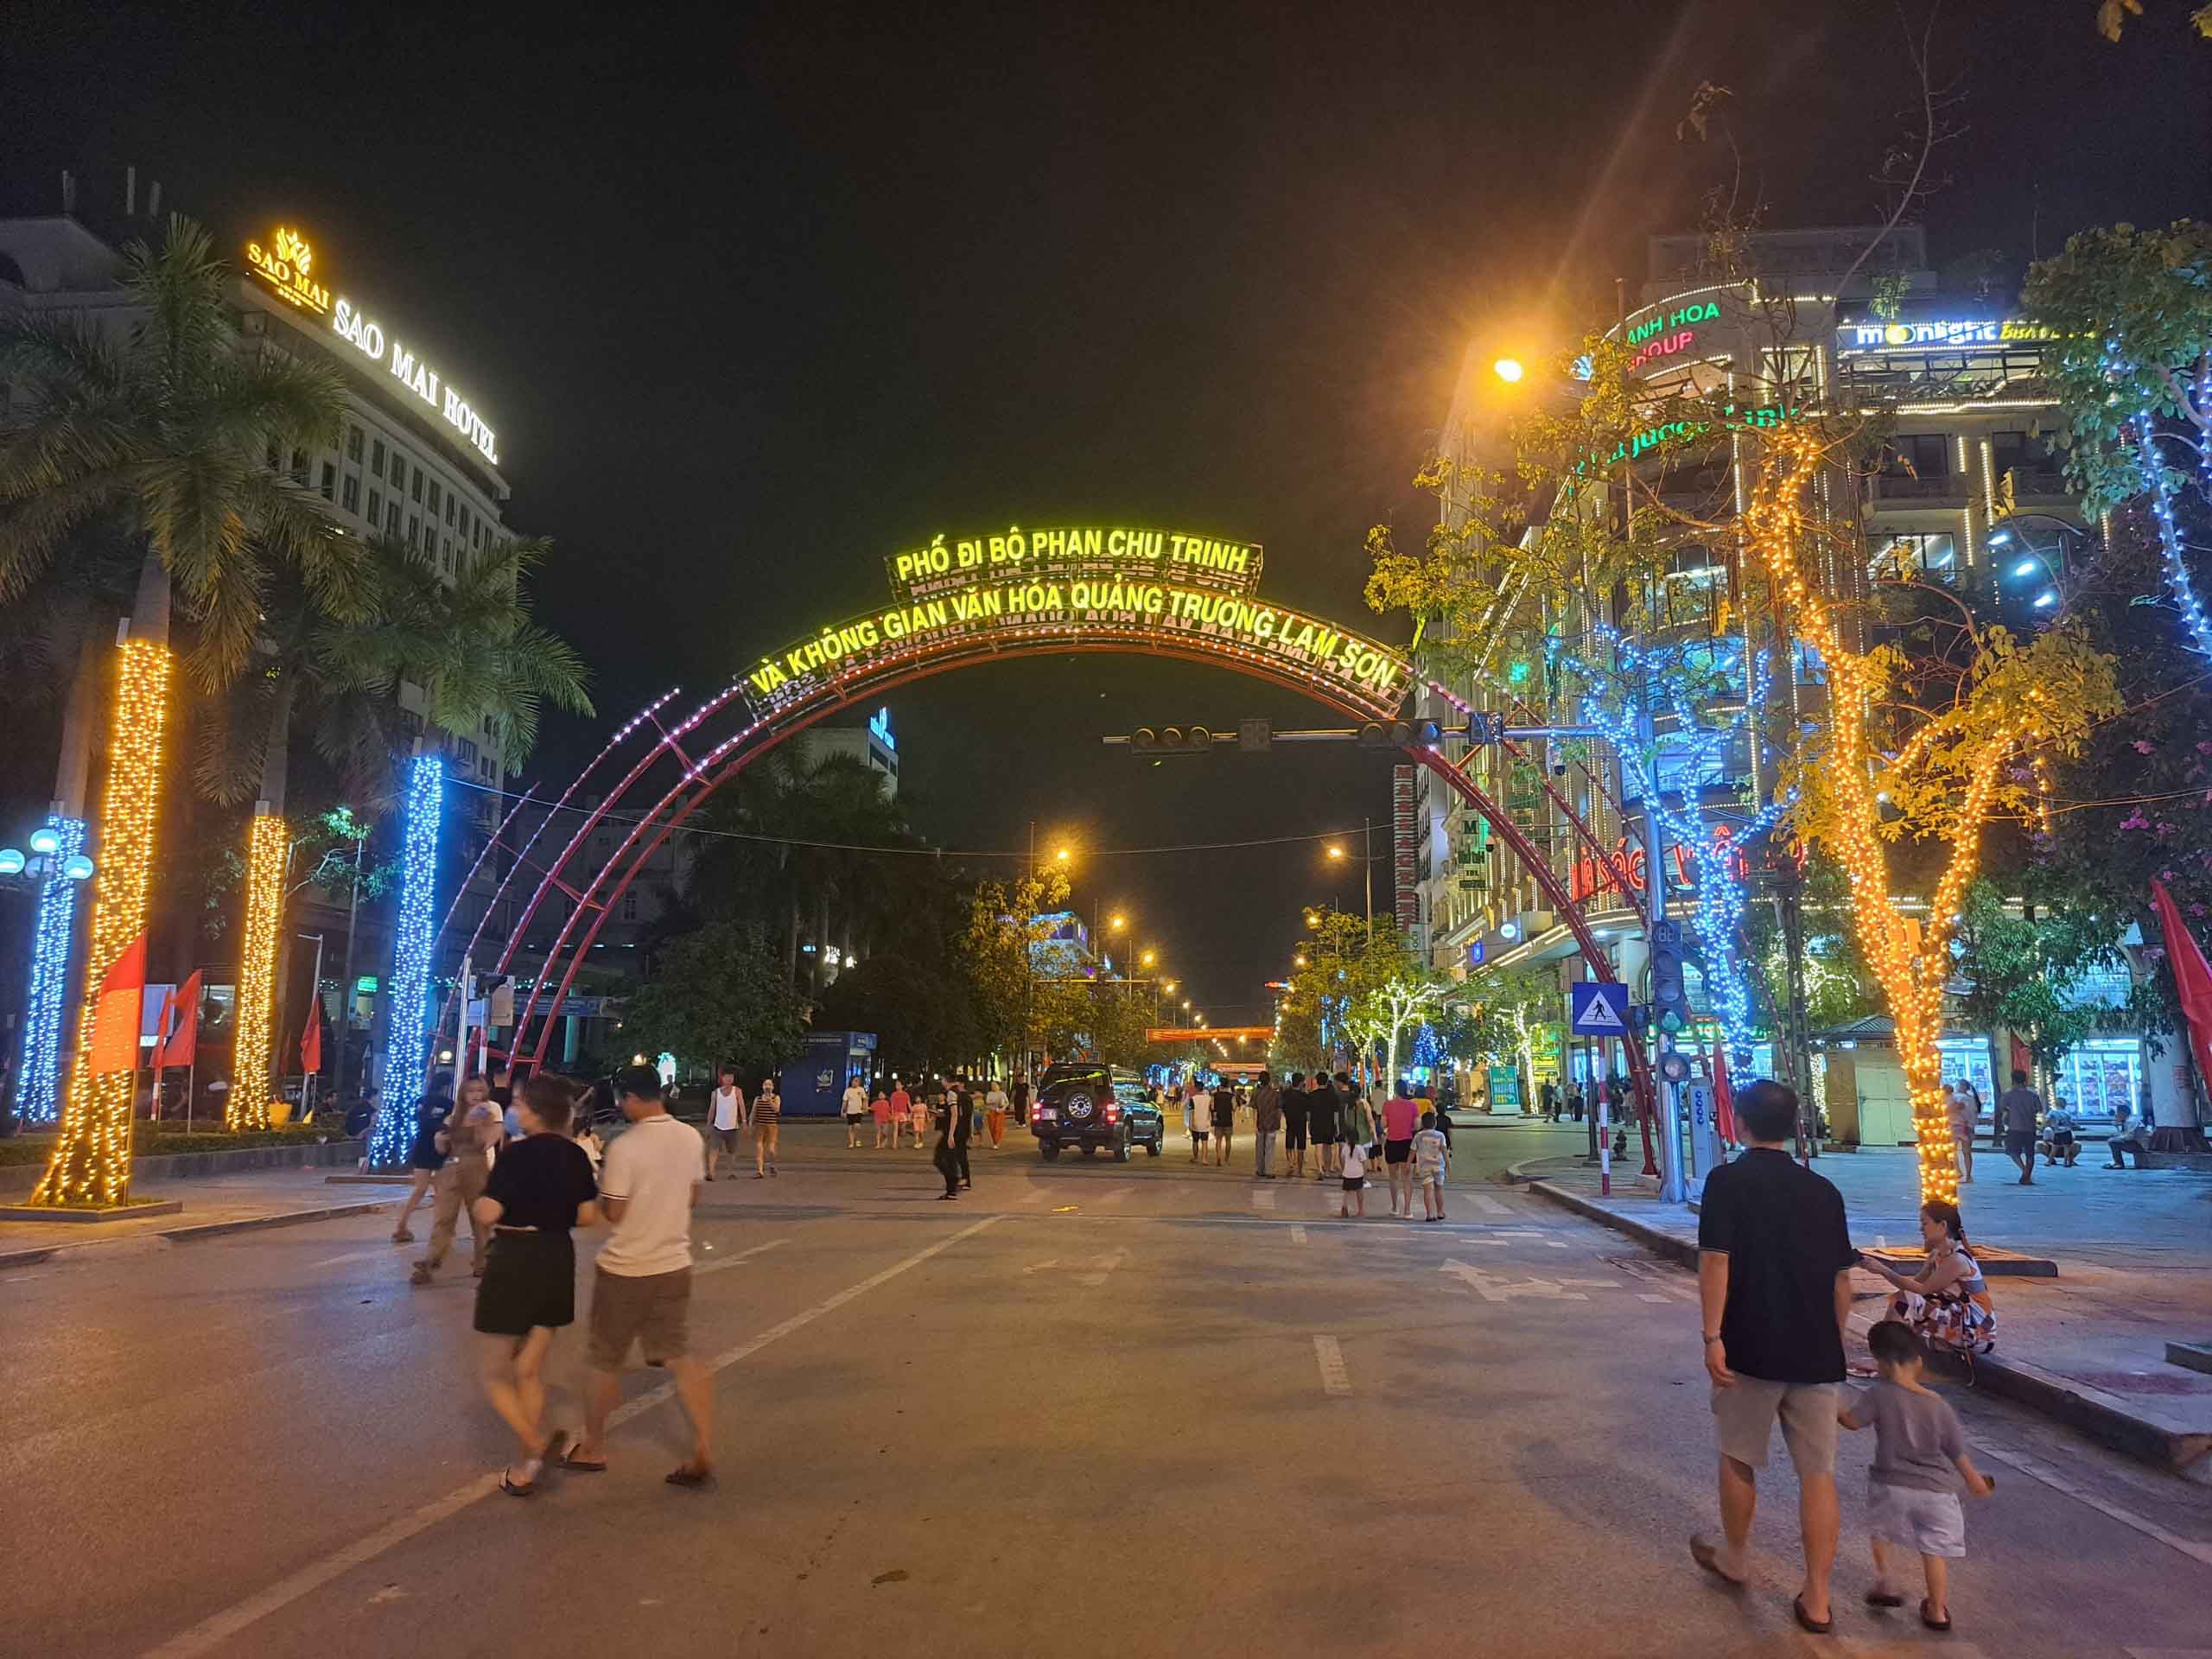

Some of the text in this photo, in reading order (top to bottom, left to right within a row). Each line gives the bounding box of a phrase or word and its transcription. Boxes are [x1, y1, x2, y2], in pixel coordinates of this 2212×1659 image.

[249, 243, 329, 309] SAO MAI
[1669, 302, 1720, 327] HOA
[1857, 321, 1999, 345] moonlight
[1627, 331, 1694, 373] OUP
[333, 300, 499, 465] SAO MAI HOTEL
[896, 525, 1249, 582] PHỐ ĐI BỘ PHAN CHU TRINH
[750, 658, 788, 693] VÀ
[786, 620, 880, 677] KHÔNG
[883, 600, 948, 639] GIAN
[951, 586, 1001, 621] VĂN
[1007, 576, 1063, 613] HÓA
[1071, 571, 1163, 614] QUẢNG
[1278, 617, 1339, 659] LAM
[1340, 642, 1398, 690] SƠN
